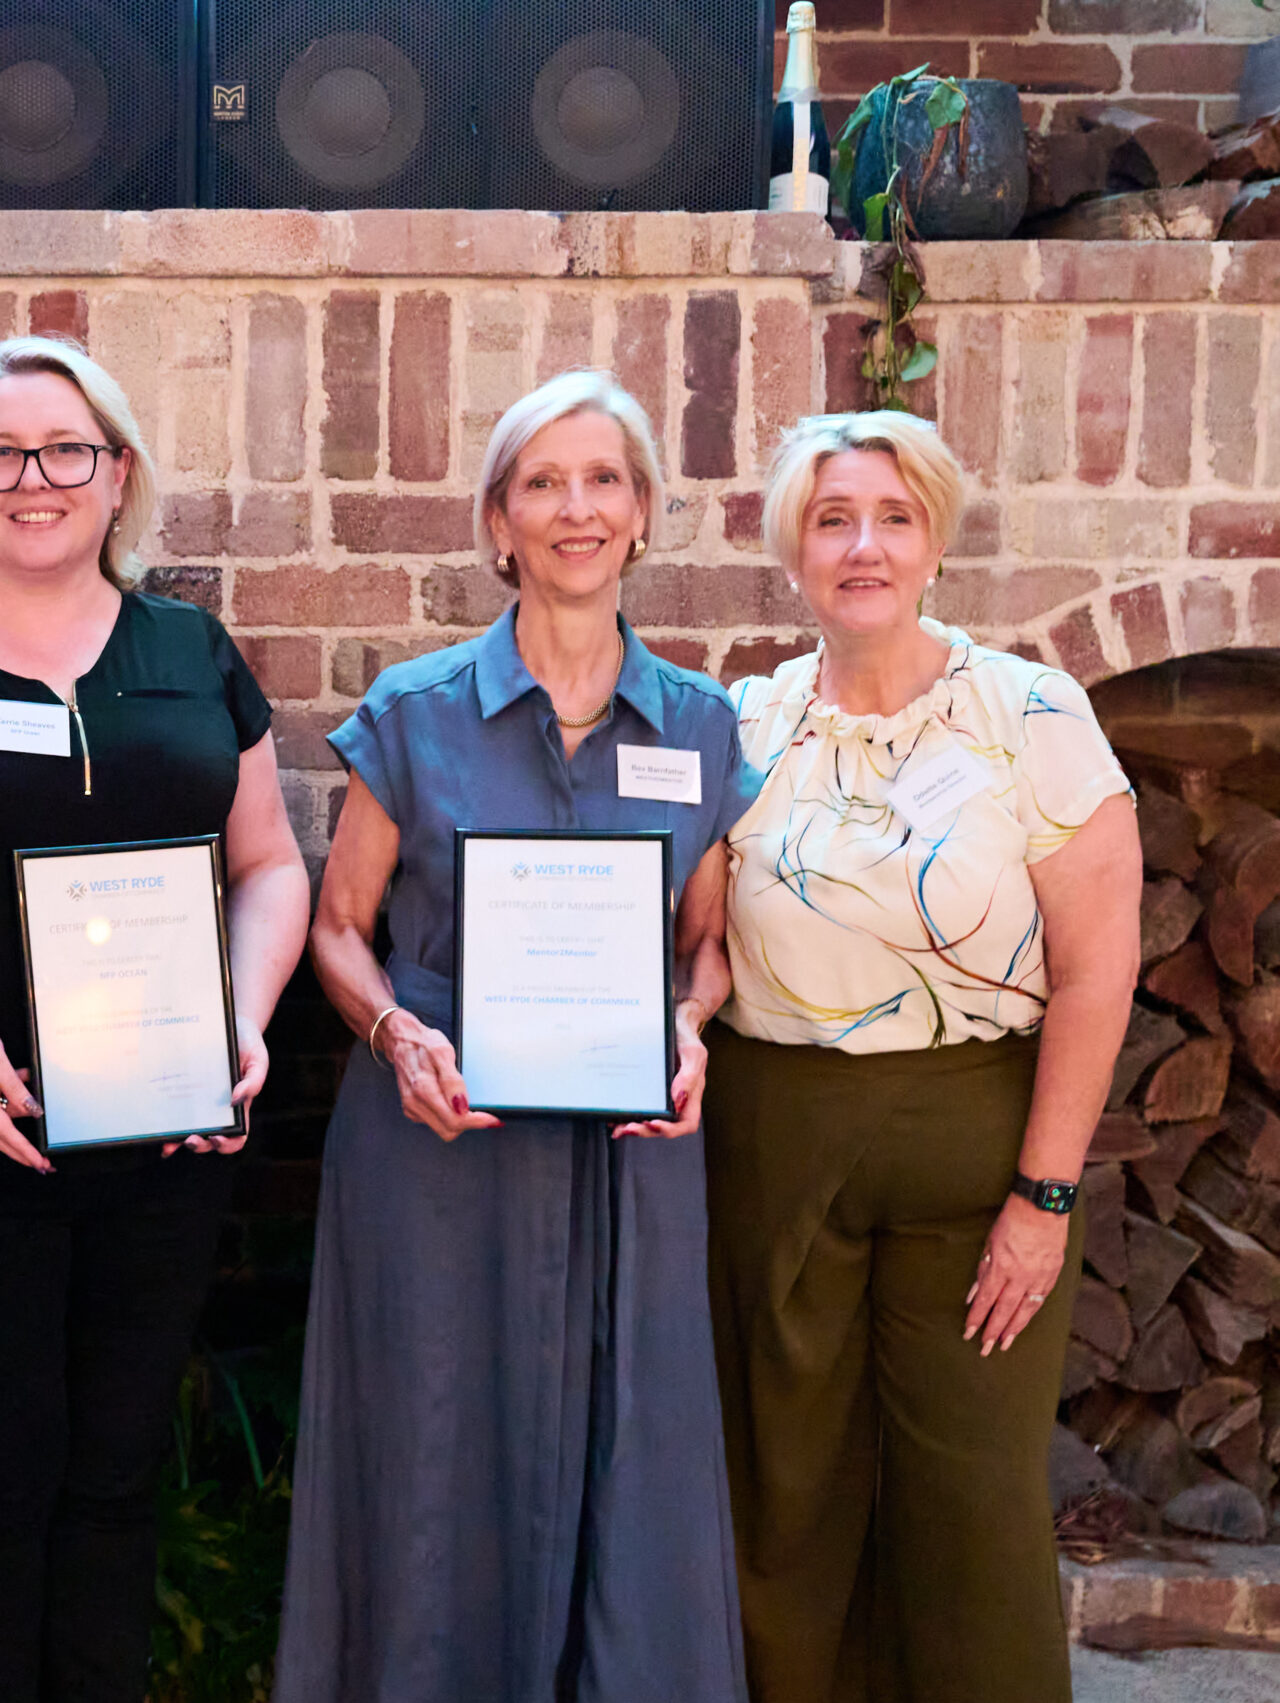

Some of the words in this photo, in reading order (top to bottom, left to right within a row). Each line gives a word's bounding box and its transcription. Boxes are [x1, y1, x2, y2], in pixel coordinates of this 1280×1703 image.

[534, 864, 575, 876] WEST
[578, 865, 614, 876] RYDE
[89, 878, 128, 893] WEST
[131, 875, 166, 889] RYDE
[488, 900, 547, 911] CERTIFICATE
[551, 901, 564, 911] OF
[567, 902, 636, 912] MEMBERSHIP
[125, 914, 189, 928] MEMBERSHIP
